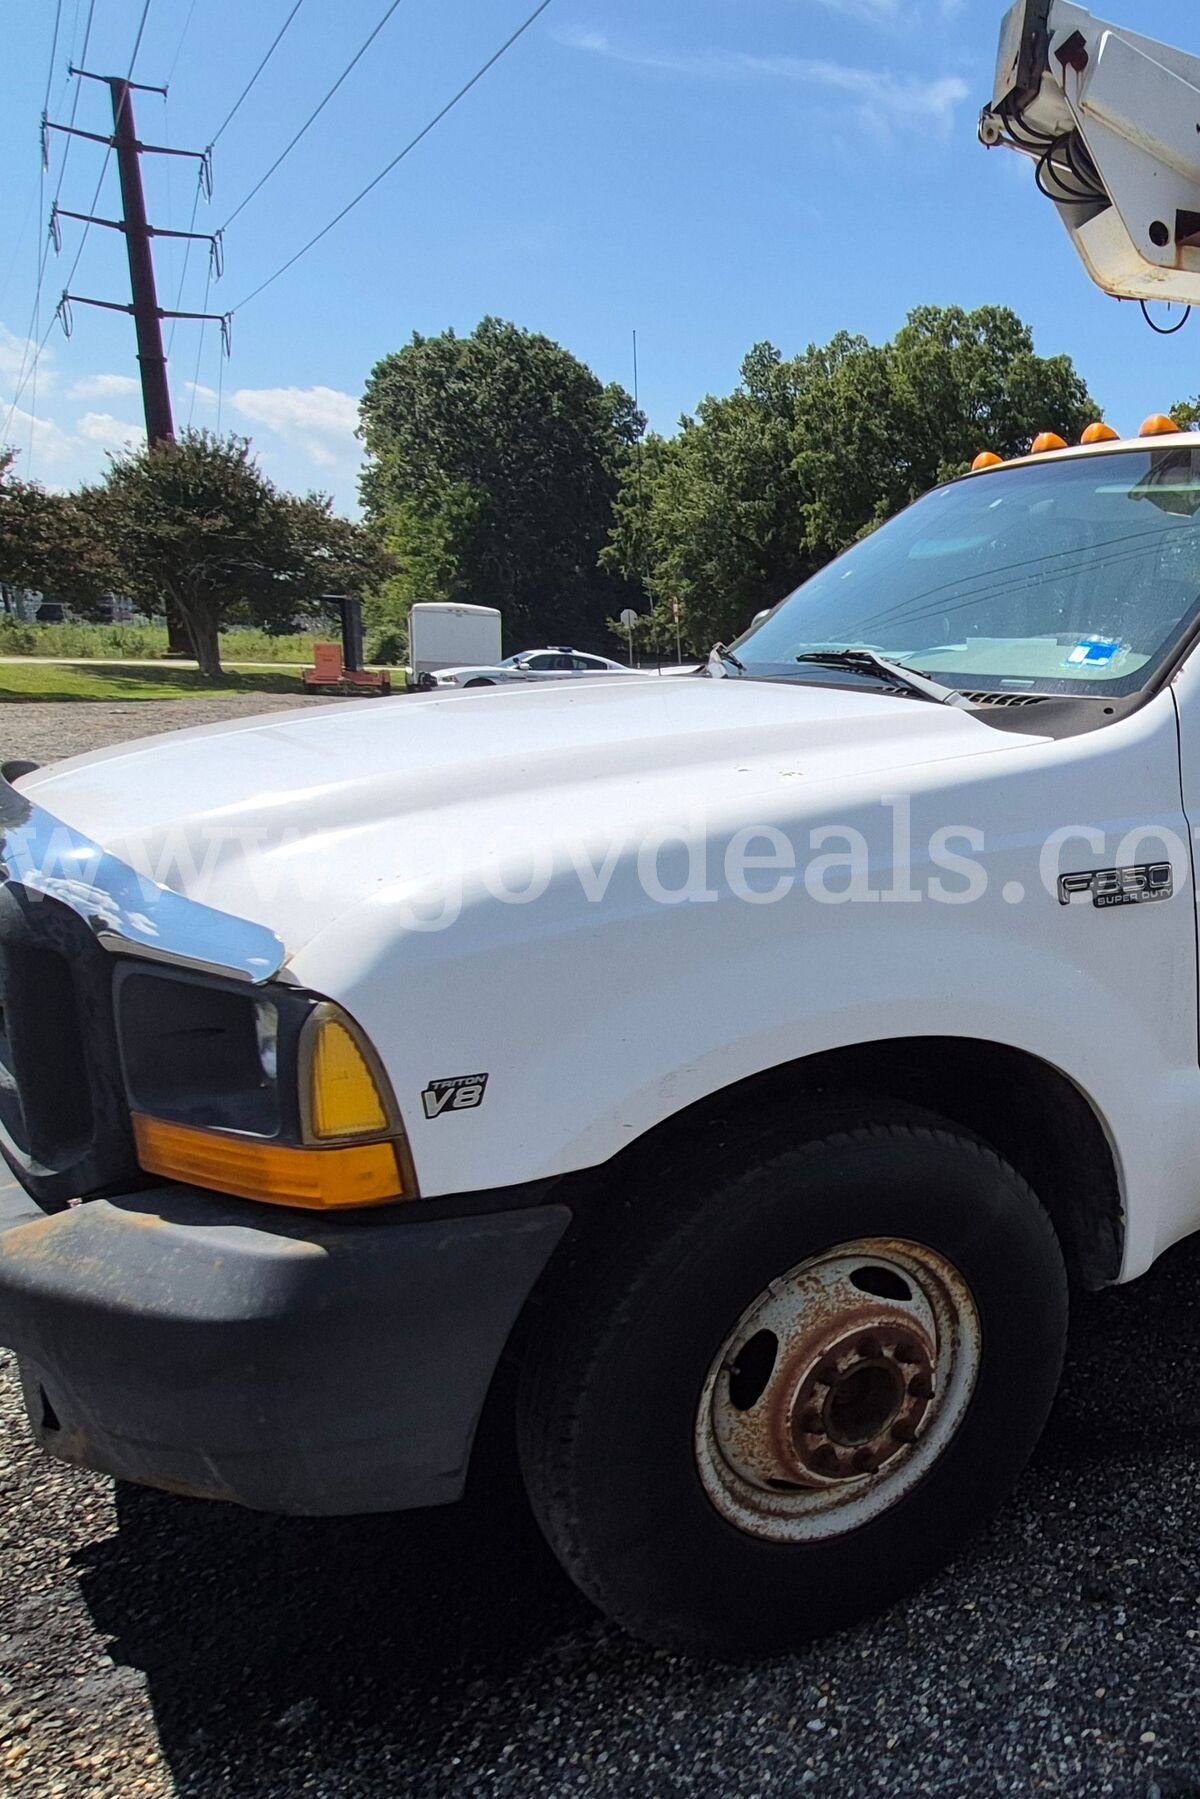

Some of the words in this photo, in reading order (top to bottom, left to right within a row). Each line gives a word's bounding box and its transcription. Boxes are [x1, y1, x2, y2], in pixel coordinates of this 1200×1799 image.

[1098, 893, 1138, 905] SUPER
[1141, 888, 1172, 899] DUTY
[431, 1075, 486, 1090] TRITON
[424, 1084, 483, 1117] V8
